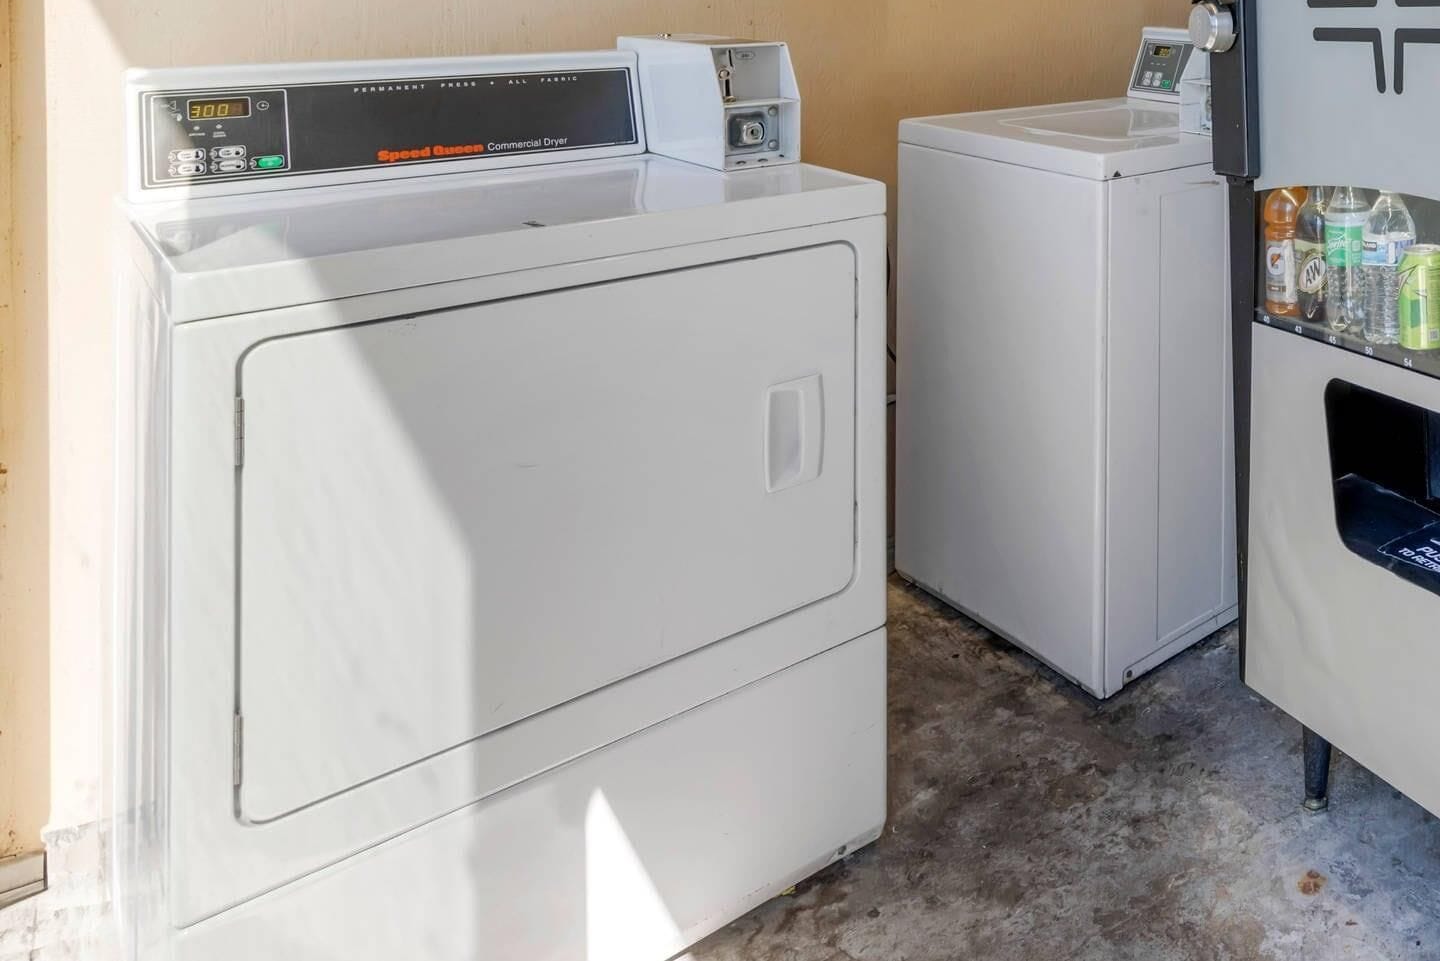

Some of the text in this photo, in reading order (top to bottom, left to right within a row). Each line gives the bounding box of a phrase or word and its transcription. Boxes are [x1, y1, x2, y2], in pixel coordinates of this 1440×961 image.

[353, 83, 425, 94] PERMANENT
[440, 80, 477, 89] PRESS
[540, 75, 578, 83] FABRIC
[377, 136, 568, 163] Speed Queen Commercial Dryer
[1364, 346, 1374, 356] 50
[1403, 357, 1413, 368] 54
[1398, 547, 1416, 558] TO
